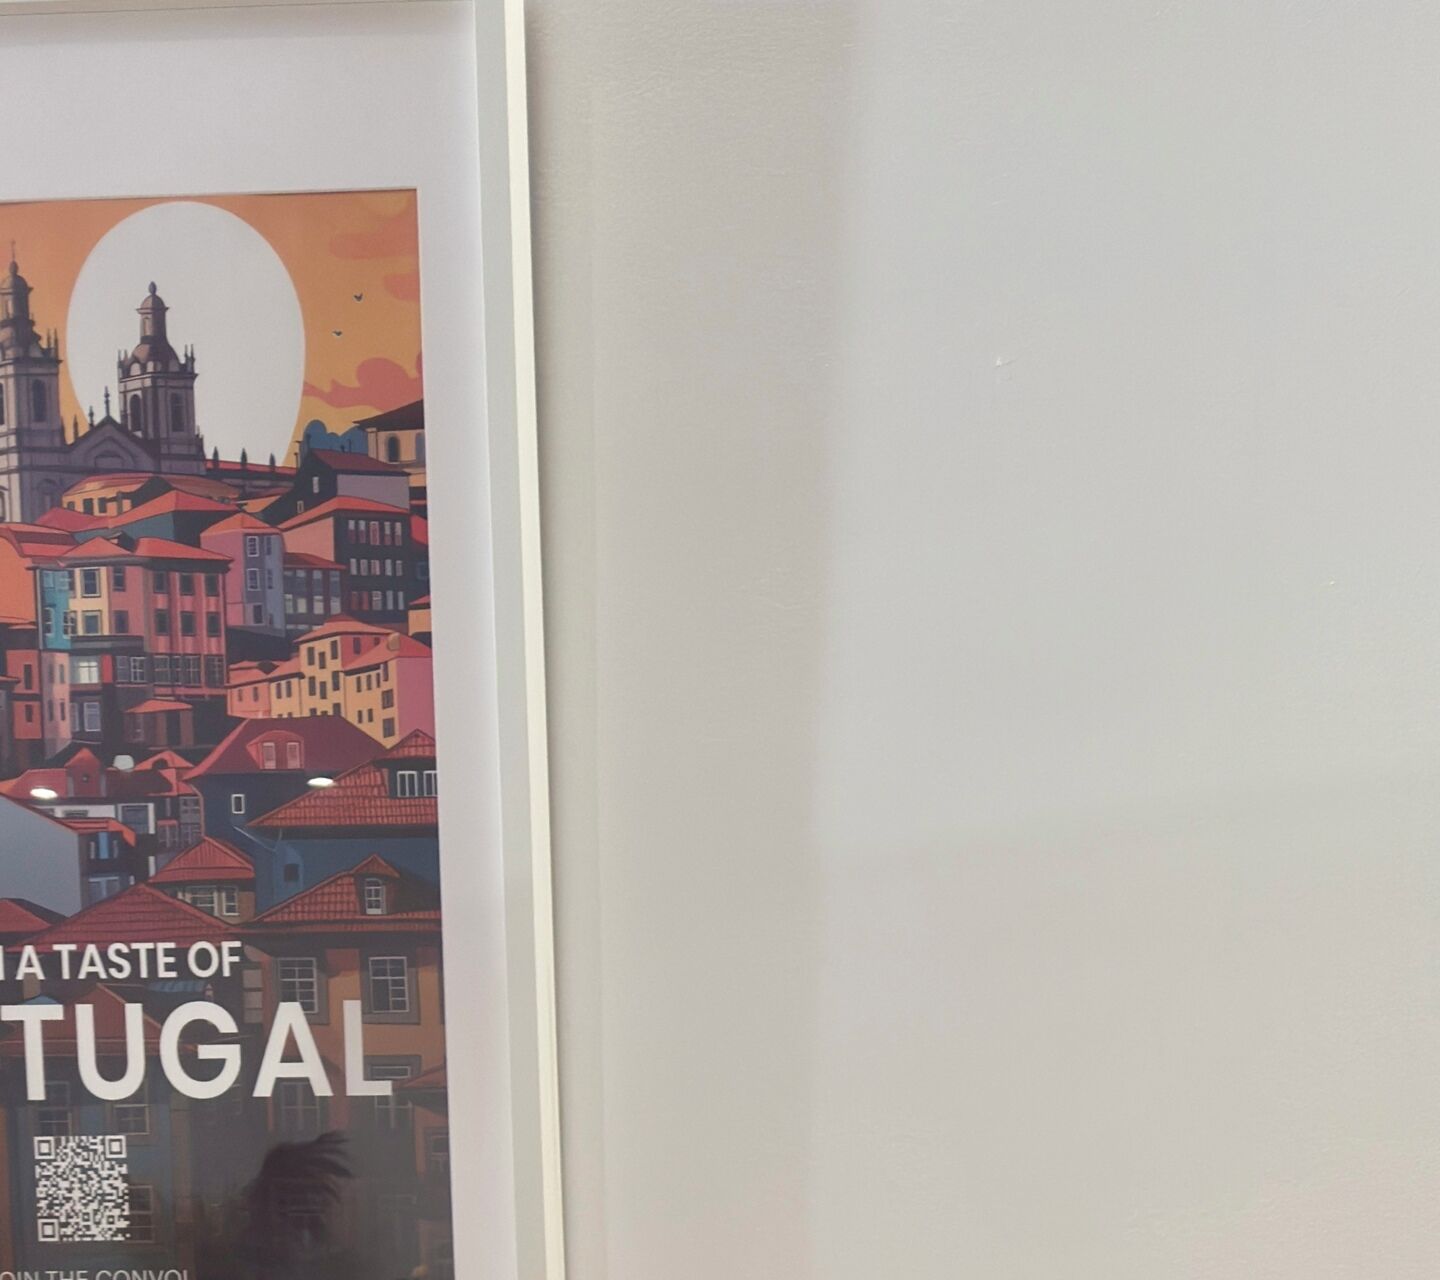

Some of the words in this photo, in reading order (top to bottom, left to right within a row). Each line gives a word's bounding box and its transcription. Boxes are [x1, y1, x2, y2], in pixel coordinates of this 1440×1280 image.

[15, 945, 45, 980] A
[52, 942, 178, 980] TASTE
[187, 940, 242, 978] OF
[0, 1000, 393, 1101] TUGAL
